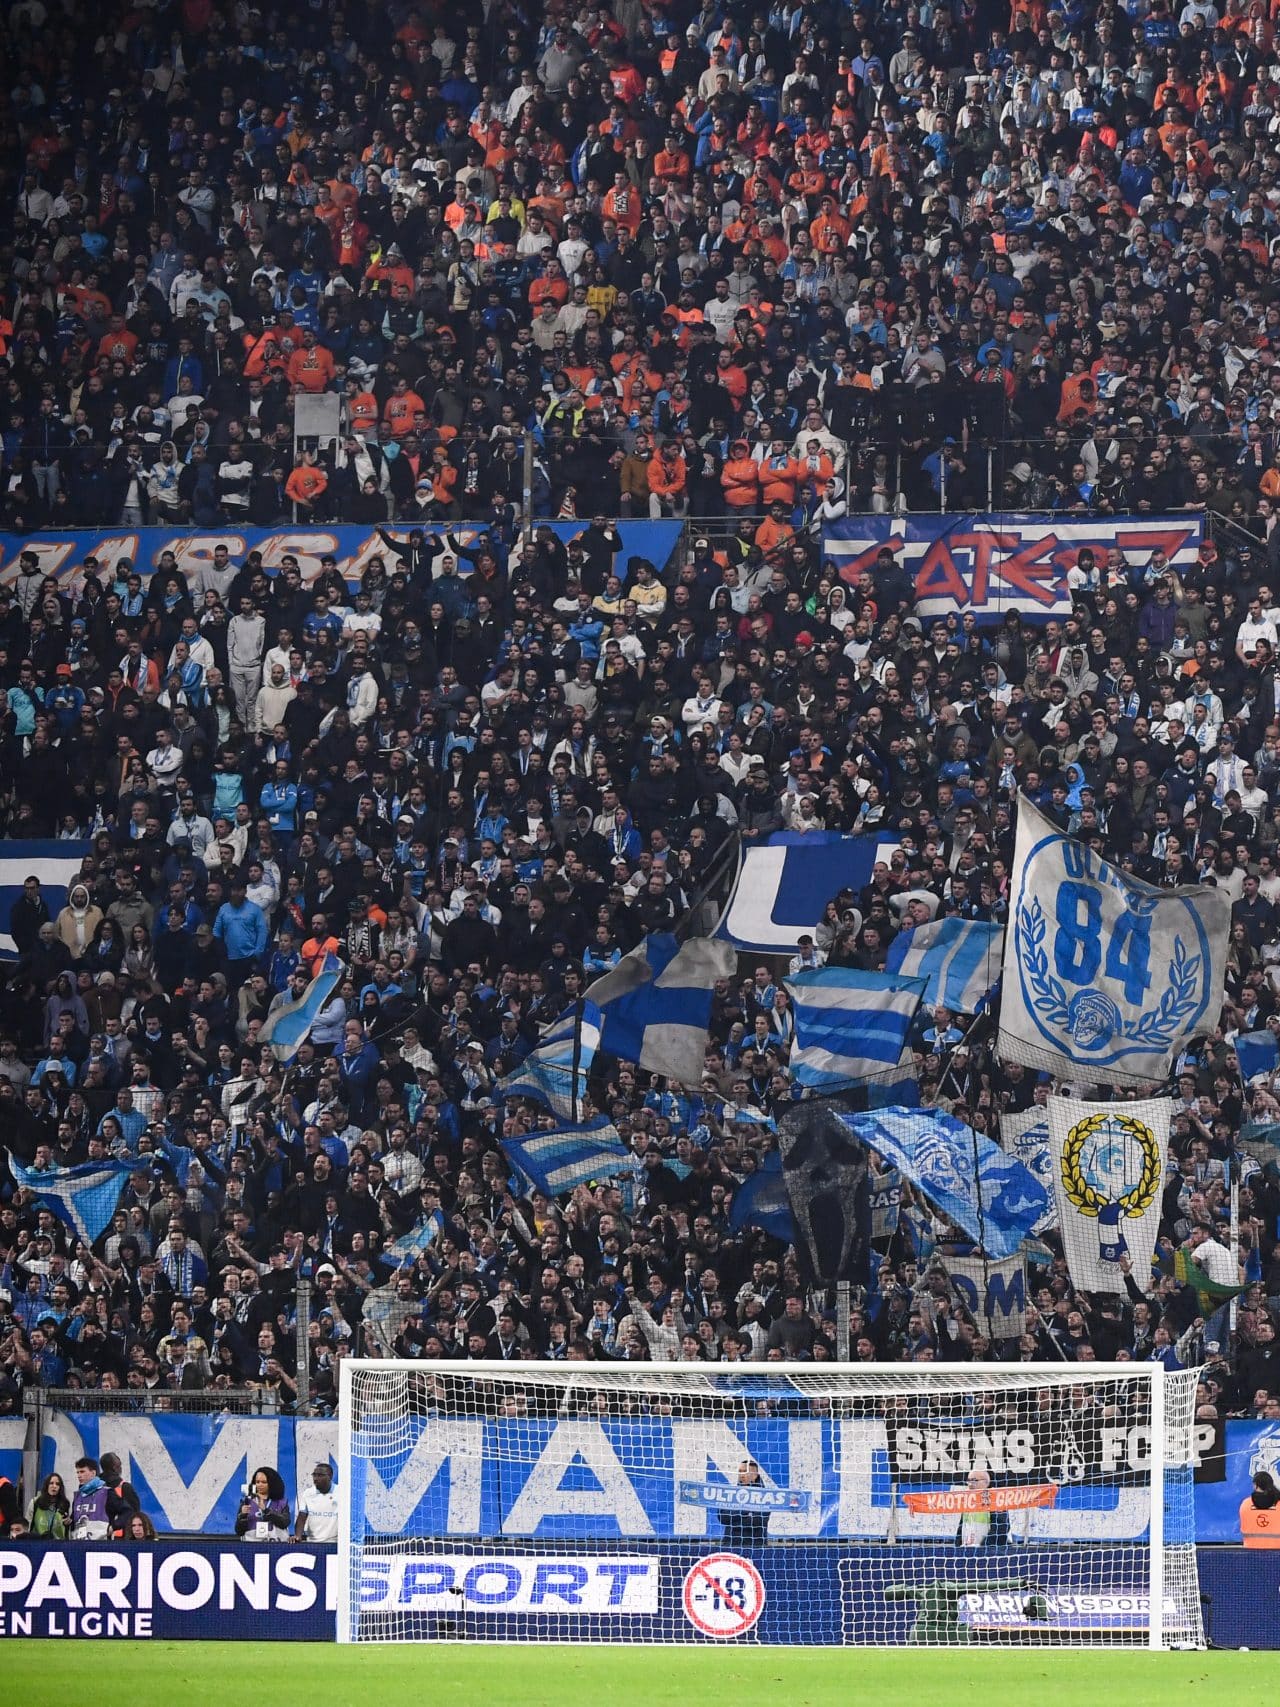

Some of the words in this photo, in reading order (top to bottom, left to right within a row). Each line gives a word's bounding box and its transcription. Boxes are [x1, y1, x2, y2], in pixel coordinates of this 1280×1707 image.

[1053, 880, 1153, 1007] 84
[895, 1427, 1035, 1474] SKINS
[0, 1551, 318, 1612] PARIONS
[1080, 1598, 1167, 1612] SPOR
[0, 1611, 32, 1636] N
[48, 1611, 153, 1637] LIGNE
